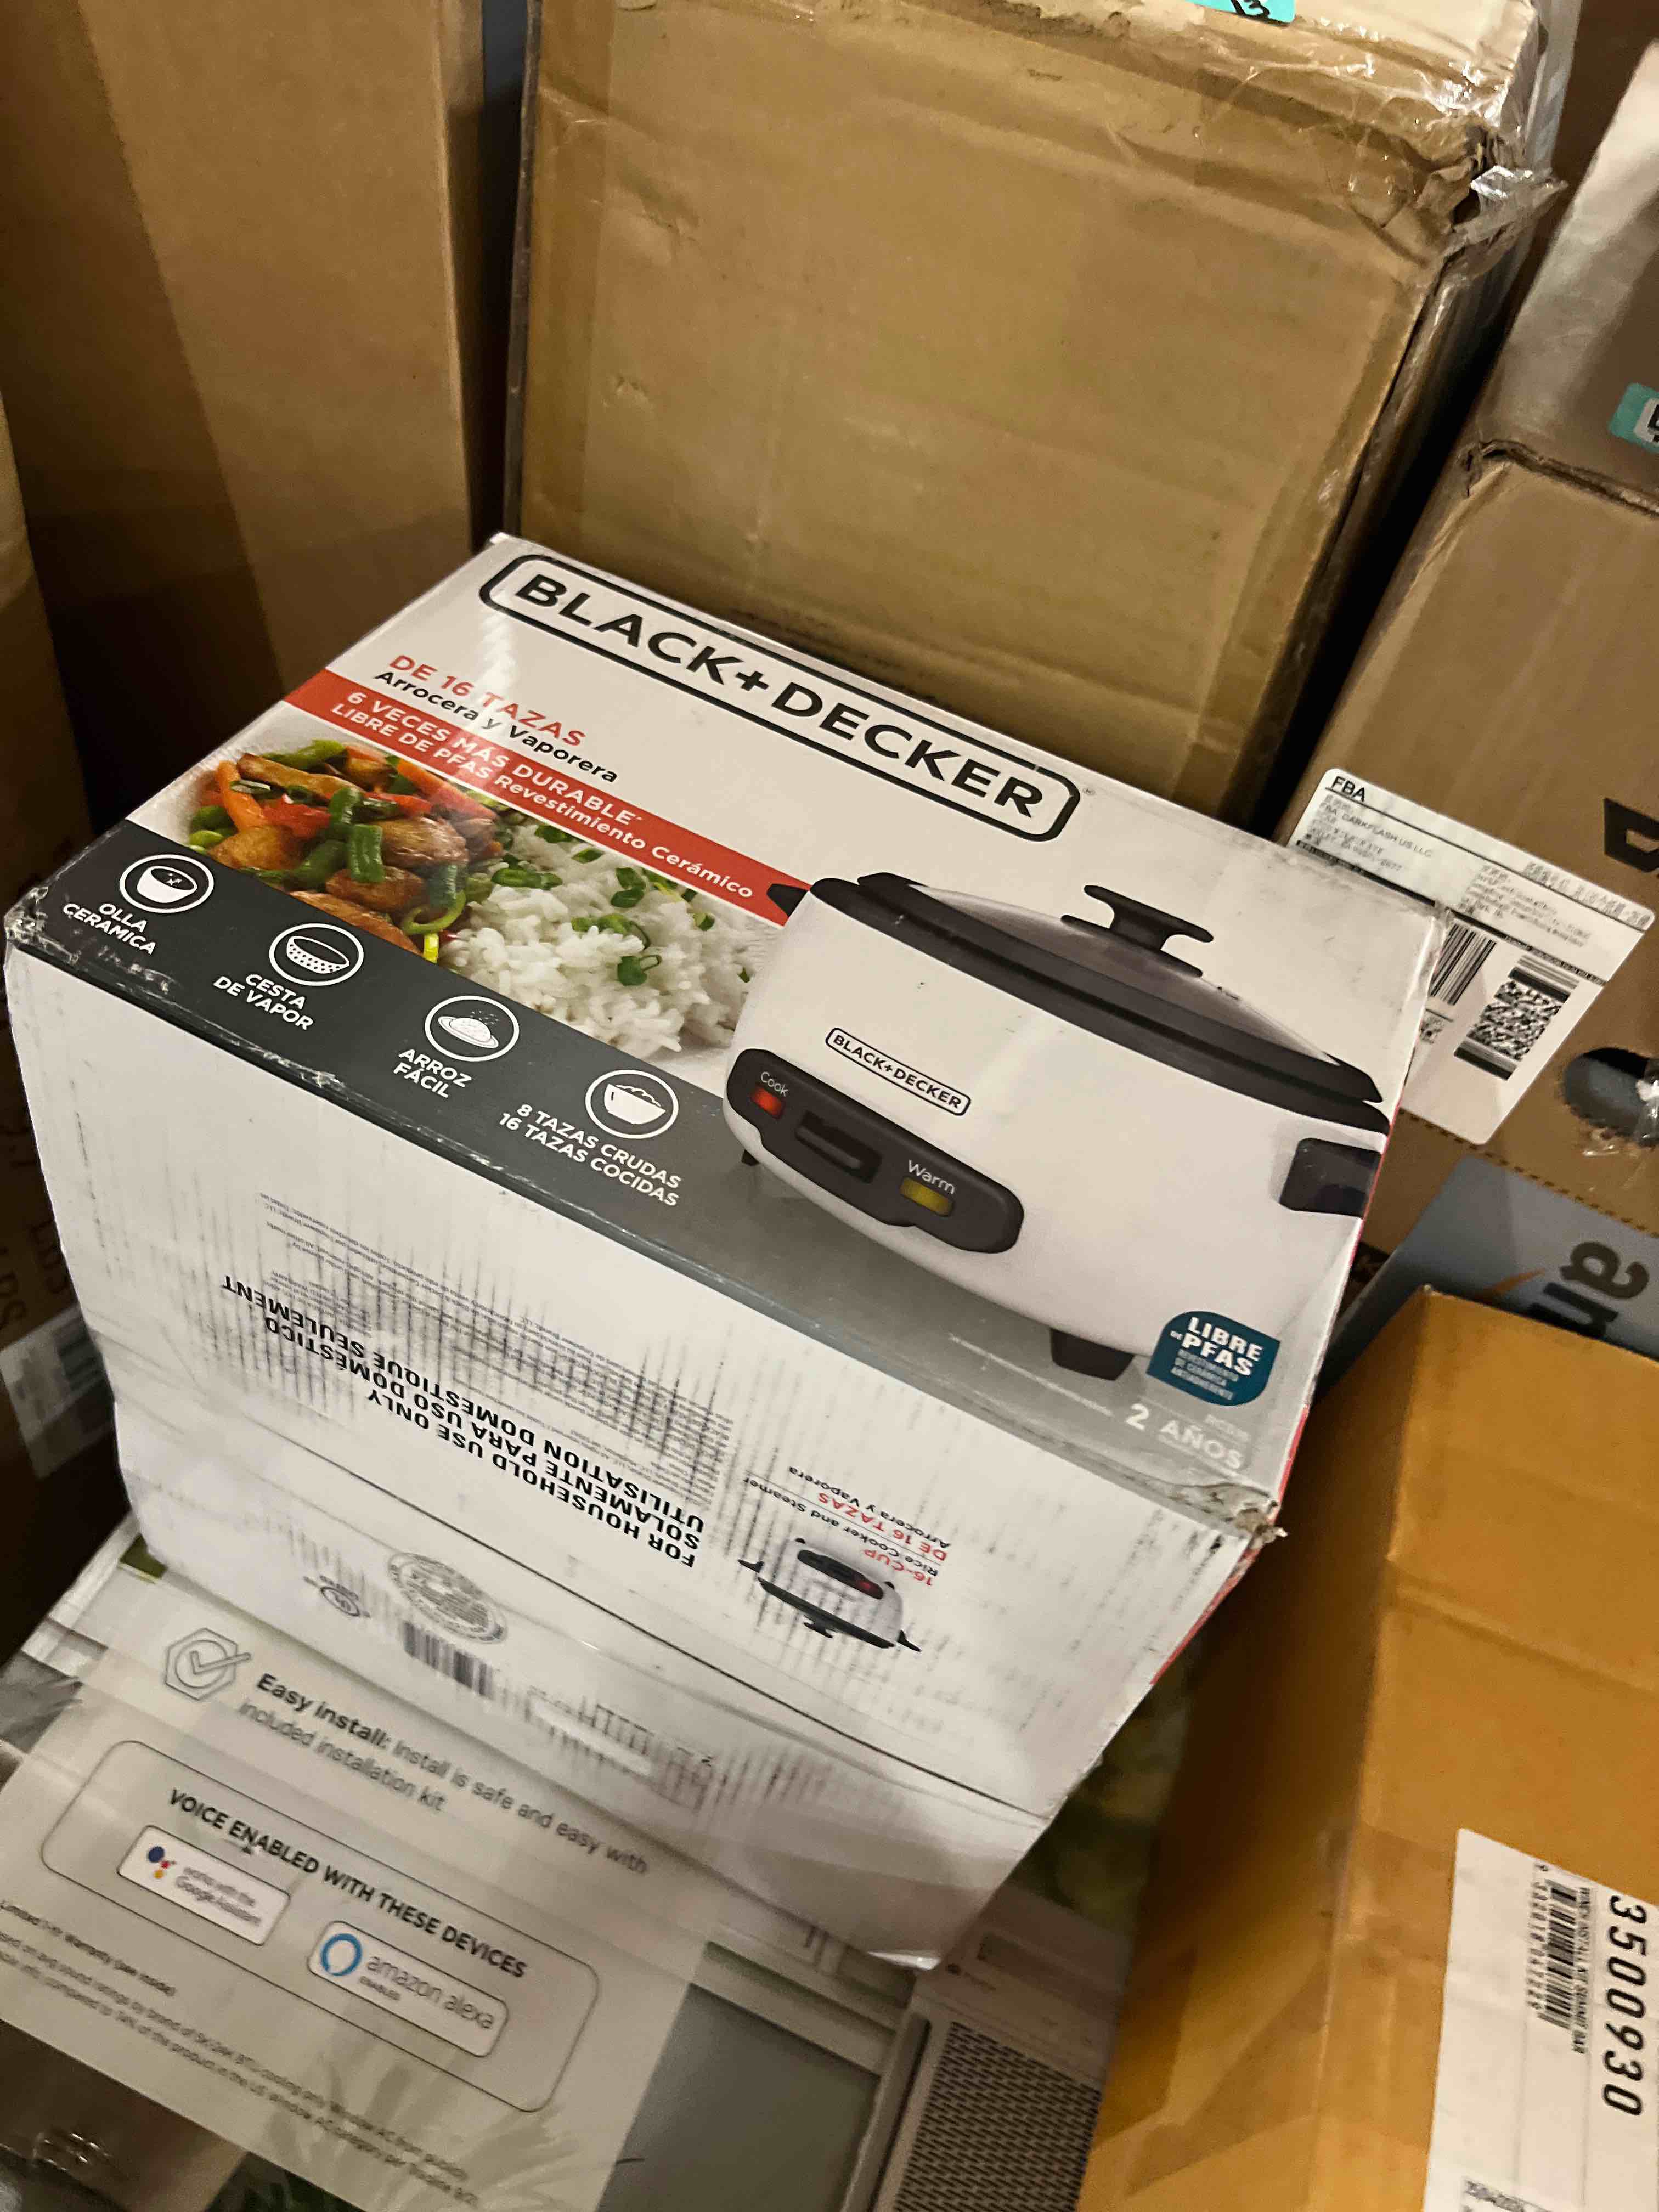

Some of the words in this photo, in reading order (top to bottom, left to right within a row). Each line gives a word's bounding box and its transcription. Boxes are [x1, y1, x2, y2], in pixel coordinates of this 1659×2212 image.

[389, 655, 437, 682] DE
[445, 675, 474, 697] 16
[483, 692, 586, 747] TAZAS
[515, 574, 1043, 819] BLACK+DECKER
[347, 691, 364, 706] 6
[371, 701, 449, 741] VECES
[455, 730, 509, 767] MÁS
[374, 671, 479, 721] Arrocera
[483, 717, 504, 731] y
[508, 724, 618, 783] Vaporera
[331, 703, 396, 737] LIBRE
[398, 731, 431, 753] DE
[436, 746, 493, 780] PFAS
[495, 774, 646, 849] Revestimiento
[651, 847, 753, 900] Cerámico
[1331, 776, 1366, 802] FBA
[63, 902, 157, 955] CERAMICA
[99, 903, 148, 933] OLLA
[213, 975, 246, 997] DE
[249, 990, 314, 1031] VAPOR
[245, 974, 306, 1010] CESTA
[393, 1061, 449, 1098] FÁCIL
[398, 1048, 473, 1088] ARROZ
[760, 1071, 789, 1098] Cook
[832, 1034, 962, 1109] BLACK+DECKER
[499, 1112, 521, 1131] 16
[524, 1125, 586, 1163] TAZAS
[590, 1158, 679, 1207] COCIDAS
[516, 1104, 532, 1118] 8
[535, 1111, 599, 1149] TAZAS
[600, 1143, 681, 1189] CRUDAS
[908, 1159, 956, 1194] Warm
[222, 1275, 365, 1358] SEULEMENT
[1188, 1316, 1263, 1361] LIBRE
[265, 1317, 405, 1400] DOMÉSTICO
[1181, 1332, 1254, 1376] PFAS
[366, 1388, 430, 1430] ONLY
[373, 1351, 535, 1447] DOMESTIQUE
[413, 1393, 462, 1429] USO
[437, 1423, 483, 1458] USE
[471, 1421, 538, 1468] PARA
[1125, 1403, 1149, 1431] 2
[1160, 1420, 1244, 1471] AÑOS
[492, 1453, 641, 1540] HOUSEHOLD
[544, 1439, 705, 1533] UTILISATION
[546, 1460, 700, 1550] SOLAMENTE
[743, 1477, 806, 1513] Steamer
[789, 1466, 860, 1508] Vaporera
[866, 1504, 877, 1513] y
[810, 1510, 840, 1527] and
[818, 1492, 886, 1531] TAZAS
[881, 1510, 951, 1549] Arrocera
[648, 1533, 695, 1568] FOR
[843, 1526, 900, 1557] Cooker
[893, 1528, 912, 1545] 16
[919, 1542, 947, 1561] DE
[863, 1549, 933, 1587] 16-CUP
[905, 1556, 939, 1576] Rice
[256, 1673, 313, 1712] Easy
[315, 1701, 391, 1752] install:
[452, 1767, 468, 1788] is
[472, 1779, 515, 1810] safe
[517, 1803, 554, 1829] and
[556, 1822, 601, 1855] easy
[606, 1844, 649, 1875] with
[315, 1739, 417, 1804] installation
[419, 1782, 447, 1812] kit
[169, 1788, 228, 1830] VOICE
[228, 1820, 319, 1874] ENABLED
[322, 1864, 375, 1903] WITH
[377, 1892, 439, 1935] THESE
[441, 1925, 528, 1978] DEVICES
[366, 1953, 441, 2000] amazon
[1602, 1894, 1647, 2117] 3500930
